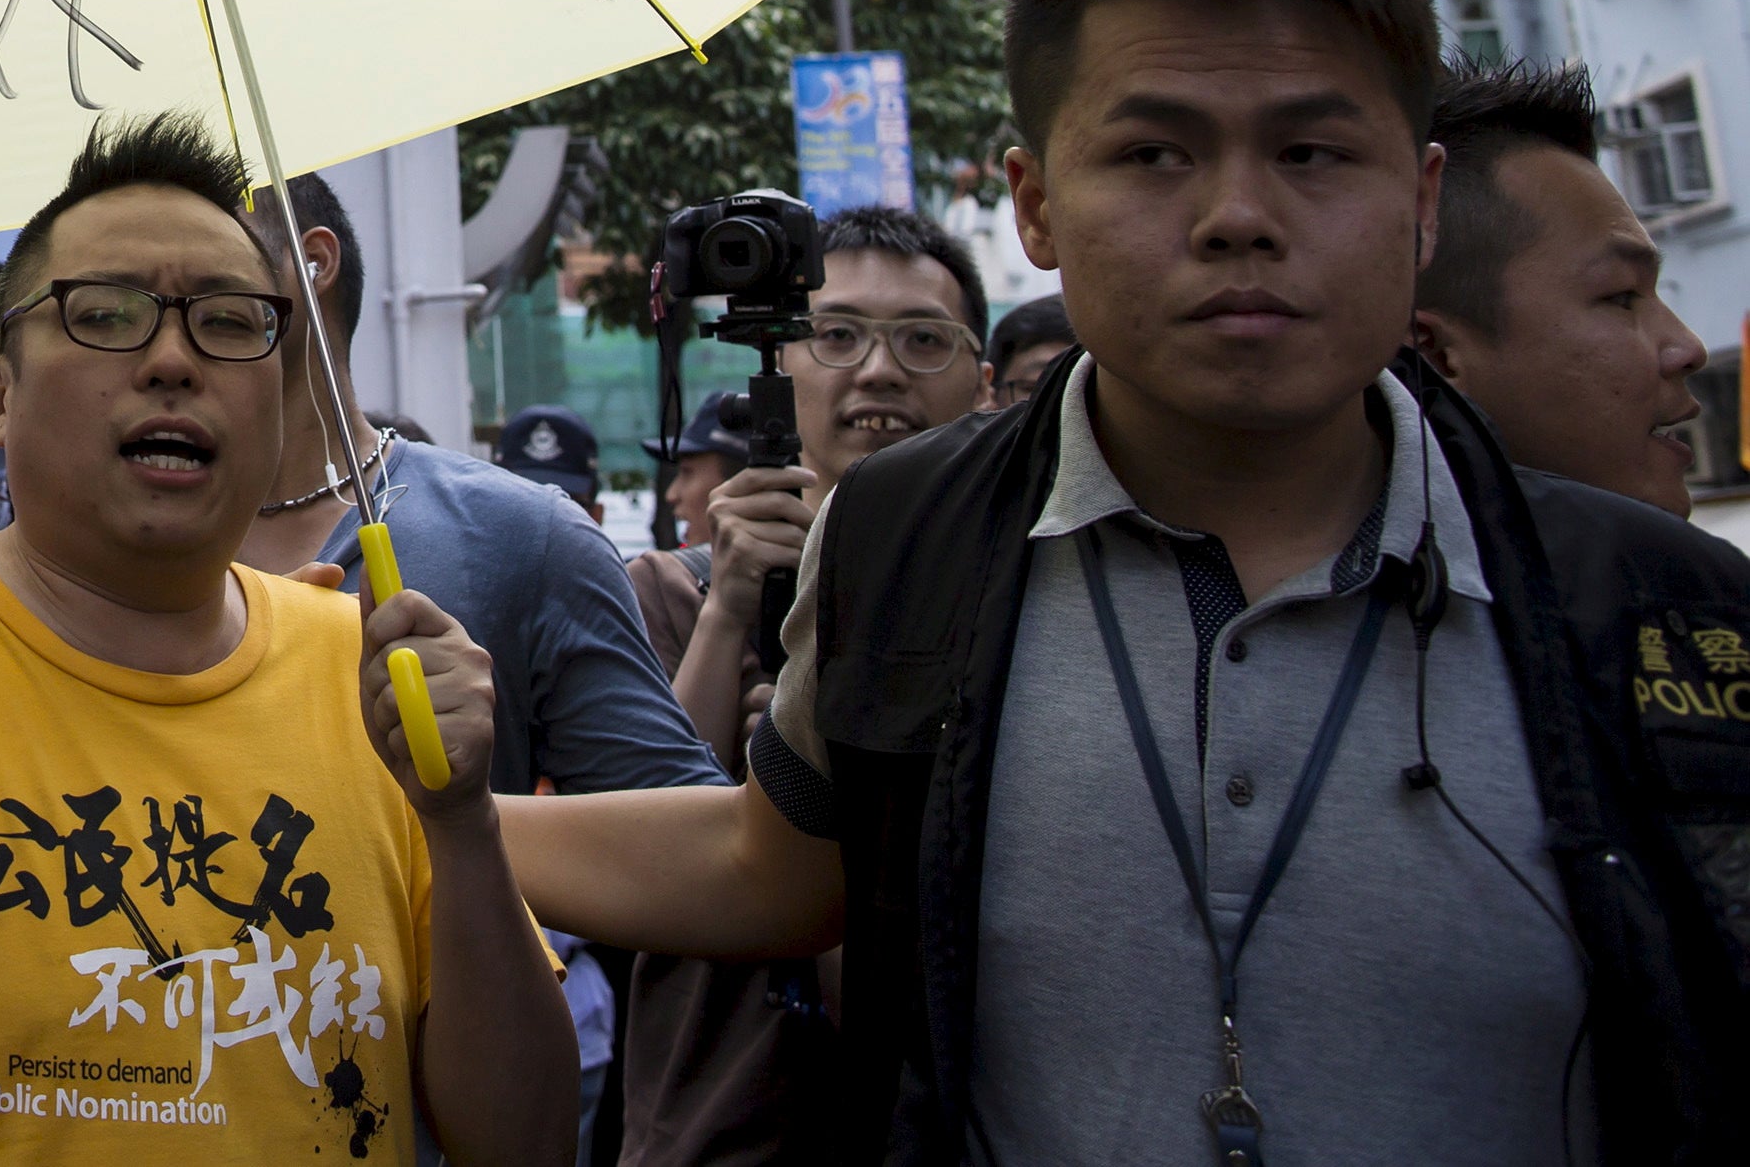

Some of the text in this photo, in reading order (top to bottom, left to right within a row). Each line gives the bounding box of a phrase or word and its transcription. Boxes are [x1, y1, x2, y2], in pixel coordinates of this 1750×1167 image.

[731, 197, 762, 207] LUMIX
[1638, 627, 1750, 674] 警察
[68, 925, 386, 1092] 不可或缺
[8, 1053, 193, 1085] Persist to demand
[55, 1087, 227, 1126] Nomination
